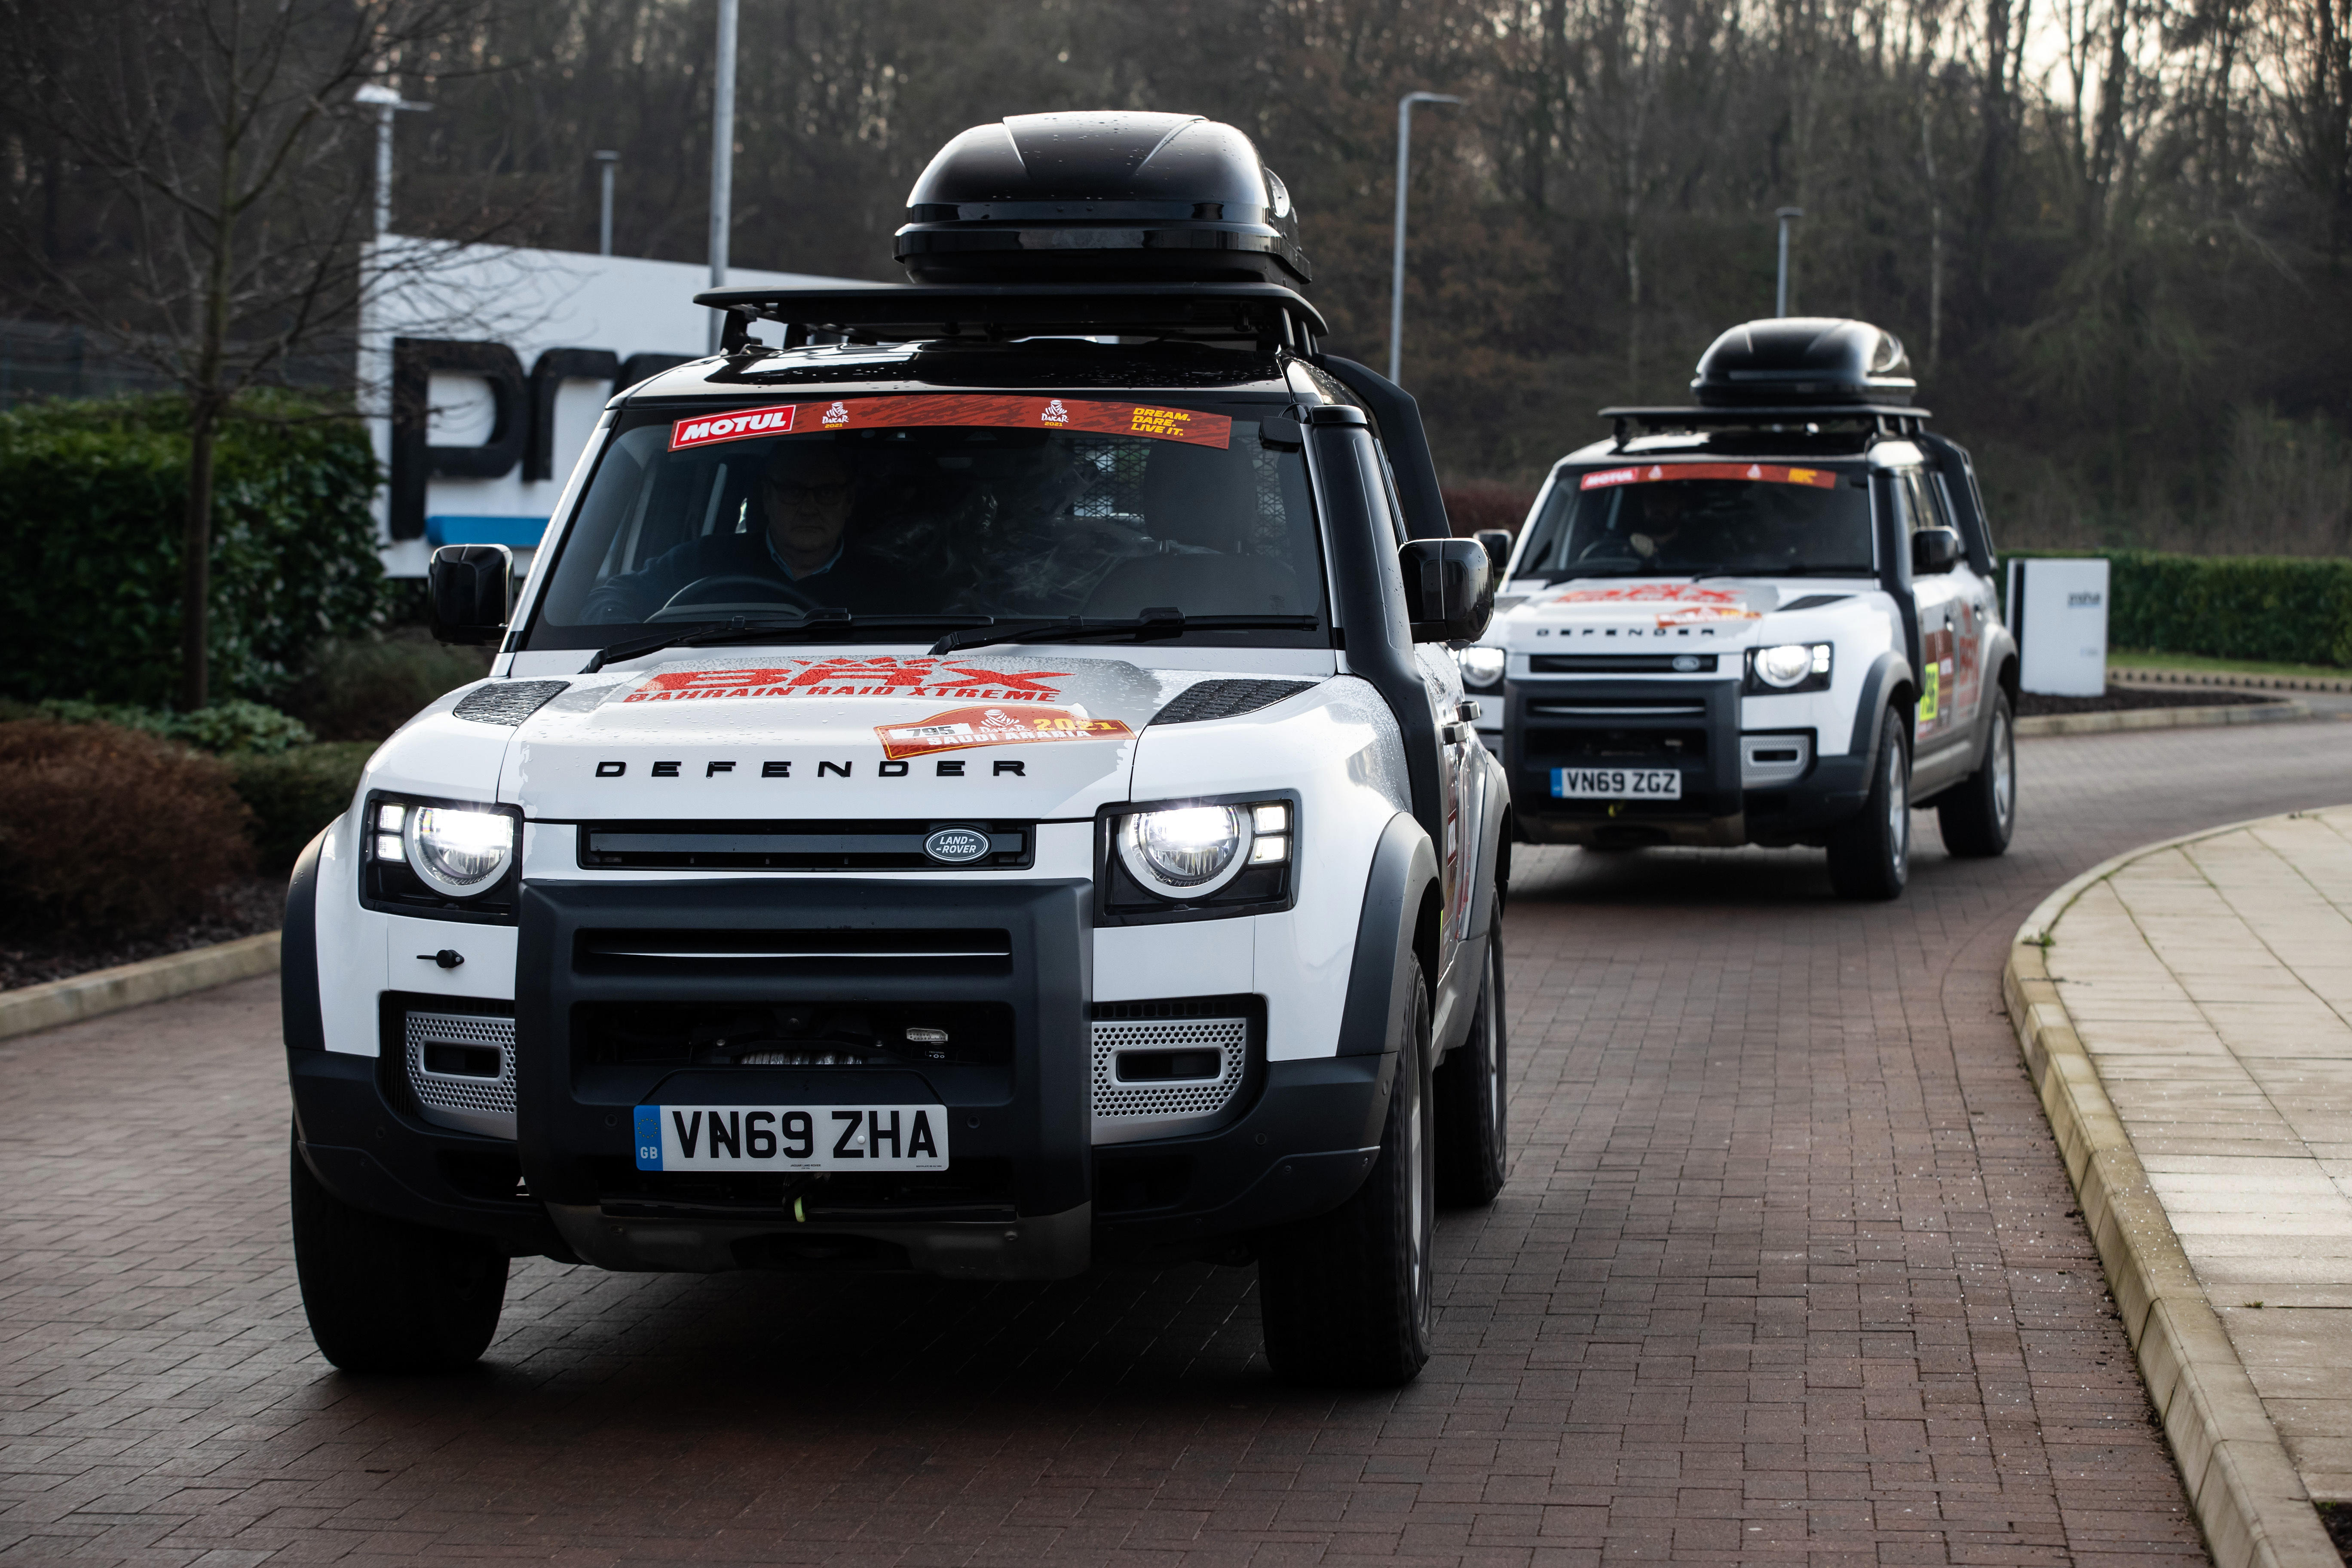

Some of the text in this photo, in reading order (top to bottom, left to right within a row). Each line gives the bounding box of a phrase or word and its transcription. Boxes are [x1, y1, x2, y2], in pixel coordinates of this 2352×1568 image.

[822, 415, 849, 424] DAKAR
[1041, 413, 1069, 423] DAKAR
[1133, 407, 1191, 421] DREAM.
[680, 412, 787, 441] MOTUL
[1132, 415, 1176, 427] DARE.
[1131, 423, 1183, 436] LIVE IT.
[622, 686, 1062, 702] BAHRAIN RAID XTREME
[978, 724, 1030, 733] DAKAR
[1033, 718, 1118, 730] 2021
[906, 726, 955, 737] 795
[926, 731, 1092, 745] SAUDI ARABIA
[595, 761, 1026, 777] DEFENDER
[1568, 772, 1676, 793] VN69 ZGZ
[940, 836, 968, 845] LAND
[942, 845, 977, 853] ROVER
[672, 1110, 938, 1158] VN69 ZHA
[640, 1146, 658, 1159] GB
